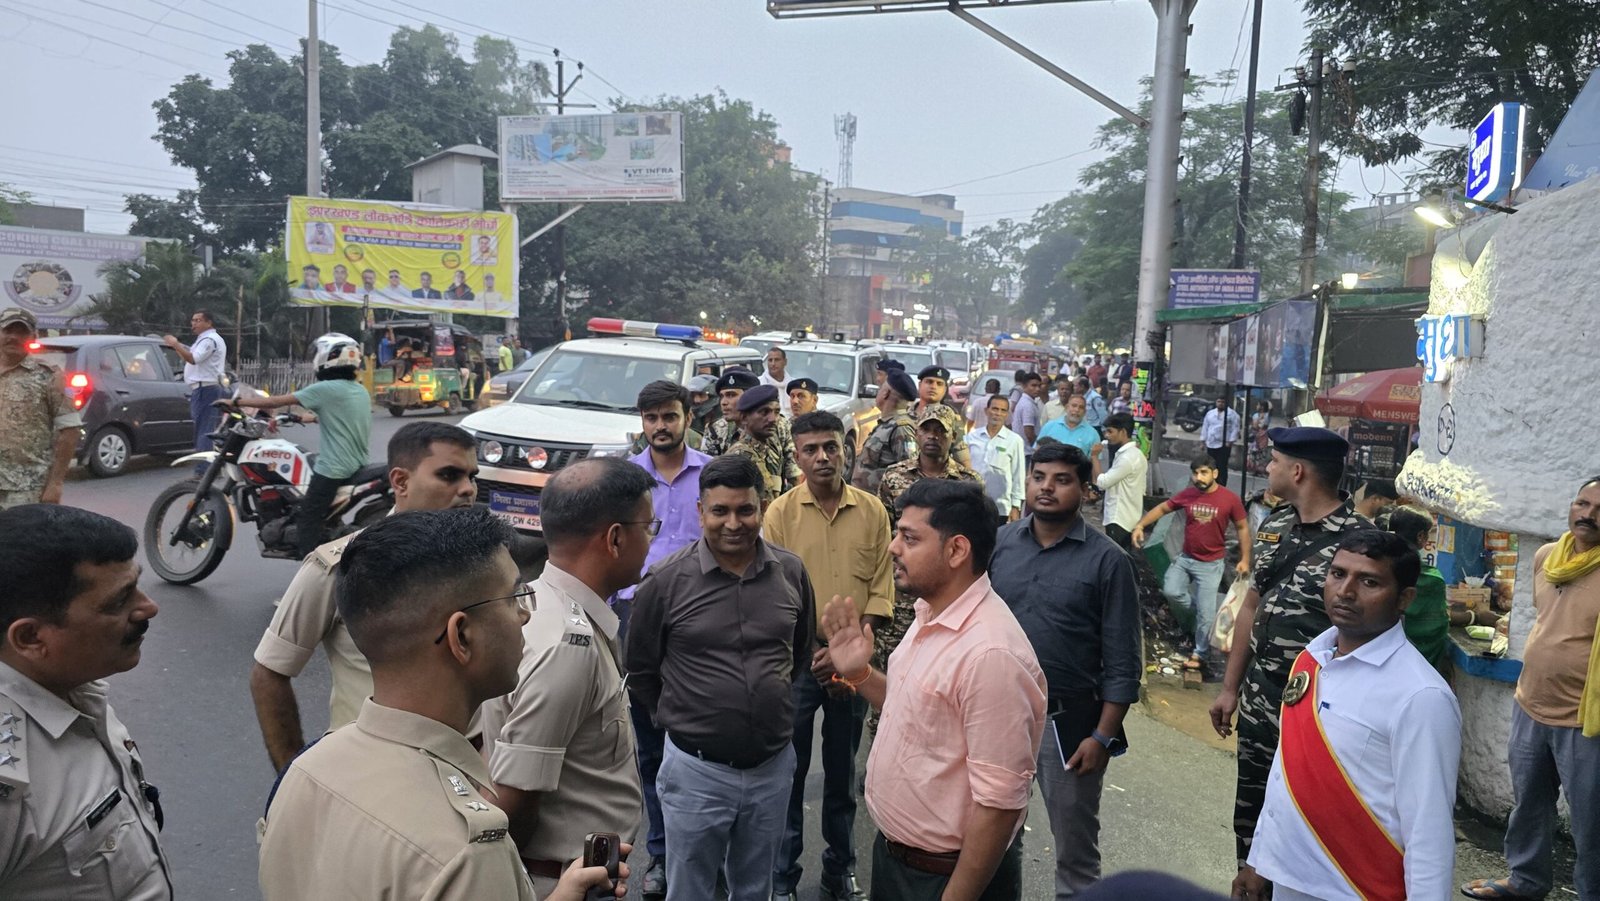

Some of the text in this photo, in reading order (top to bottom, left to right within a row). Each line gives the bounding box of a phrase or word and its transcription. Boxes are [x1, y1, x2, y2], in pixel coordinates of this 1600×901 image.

[0, 231, 137, 250] COKING COAL LIMITED
[1415, 314, 1471, 382] सुधा
[1373, 410, 1417, 421] MENSWE
[262, 450, 292, 460] Hero
[513, 516, 525, 525] CW
[568, 633, 592, 647] IPS
